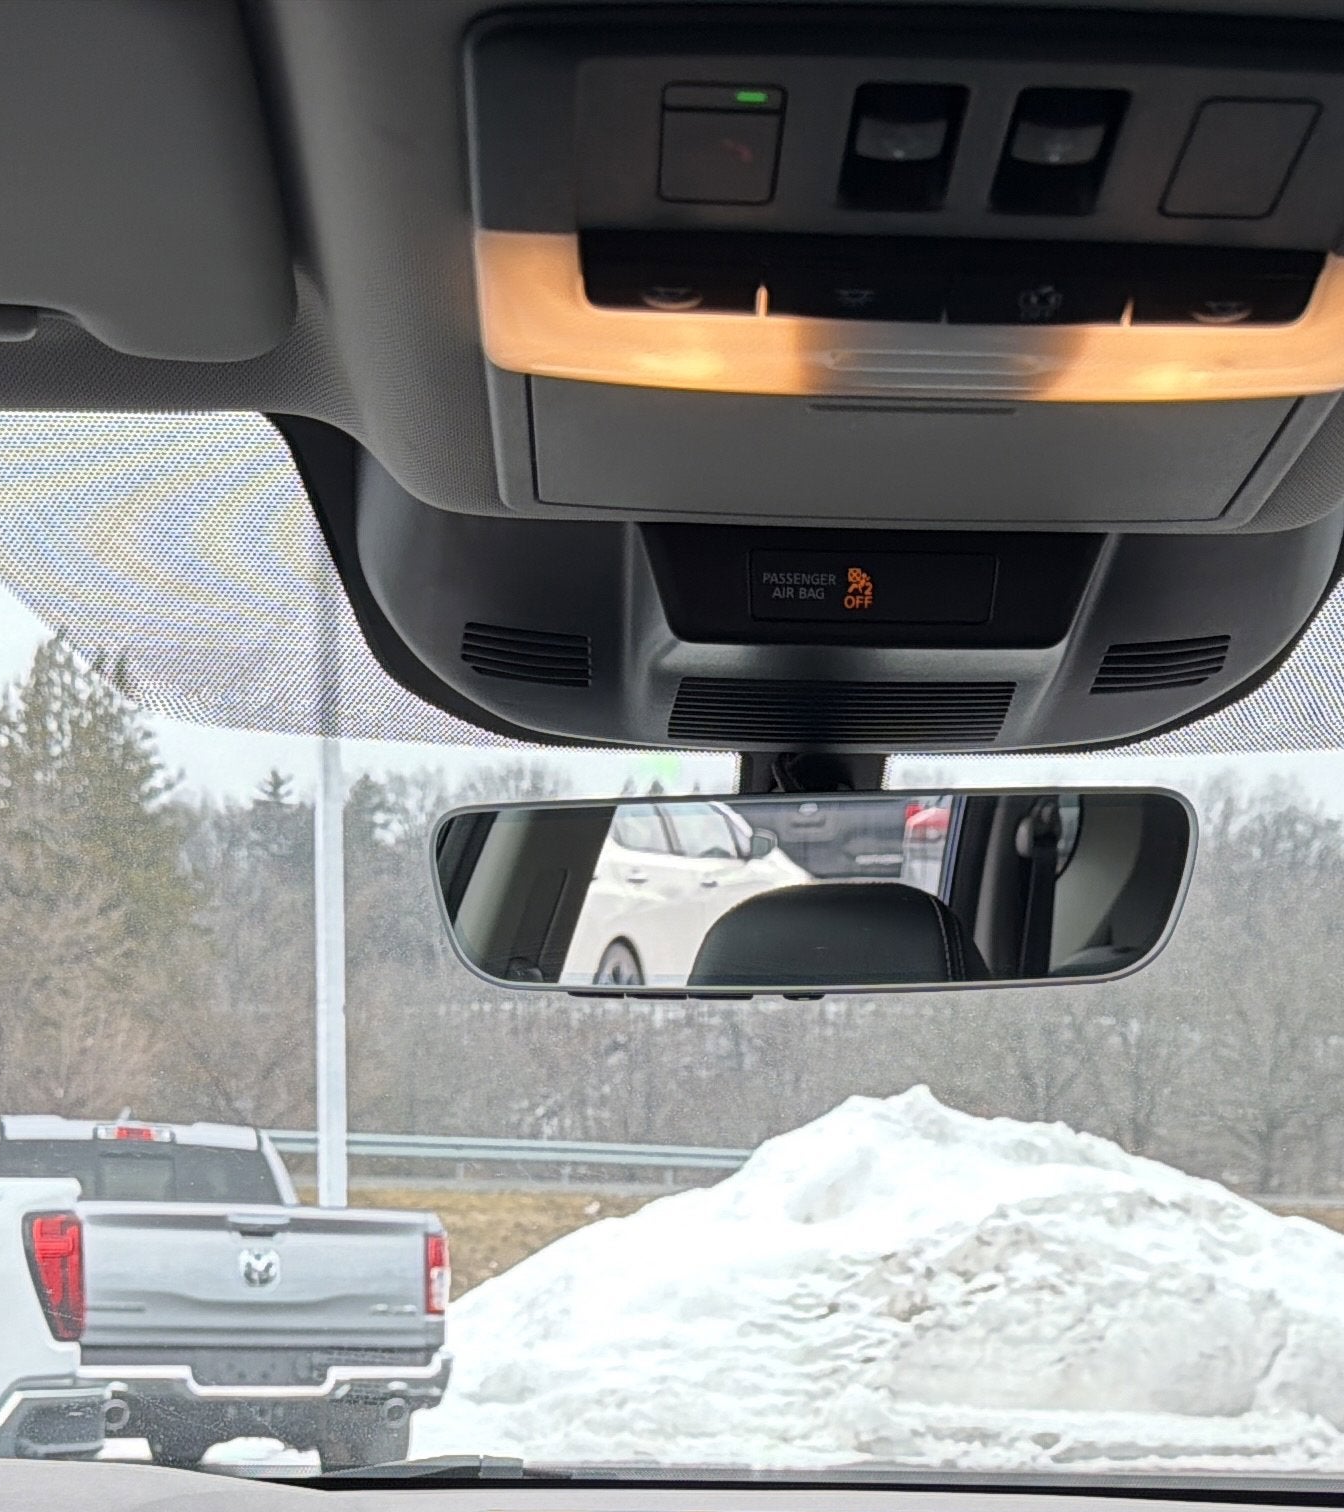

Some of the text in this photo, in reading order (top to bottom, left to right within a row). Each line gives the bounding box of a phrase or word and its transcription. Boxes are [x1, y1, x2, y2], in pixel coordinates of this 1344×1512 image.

[762, 572, 836, 586] PASSENGER
[772, 587, 825, 600] AIR BAG
[843, 596, 873, 609] OFF
